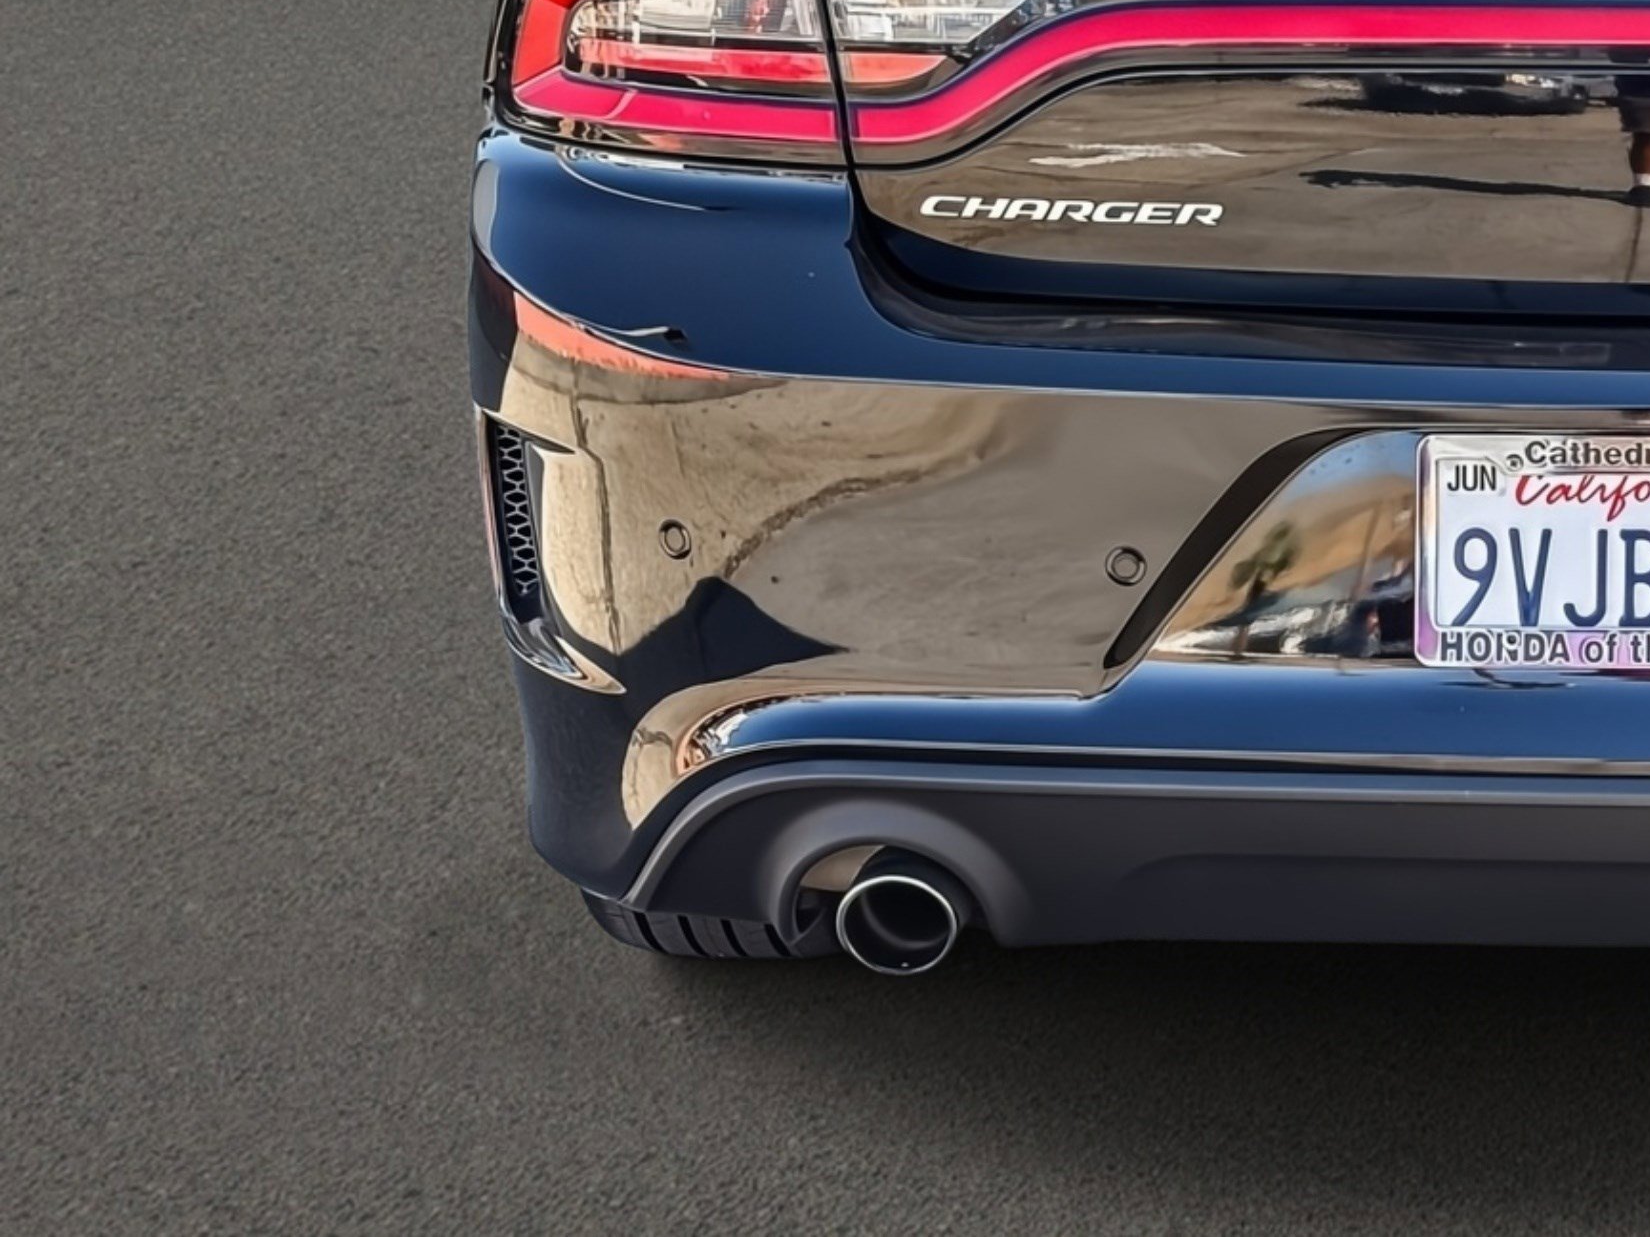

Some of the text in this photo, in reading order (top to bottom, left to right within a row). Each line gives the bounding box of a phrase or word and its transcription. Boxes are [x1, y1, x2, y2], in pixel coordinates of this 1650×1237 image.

[919, 195, 1224, 226] CHARGER
[1447, 466, 1496, 491] JUN
[1440, 633, 1568, 663] HONDA
[1579, 633, 1618, 663] of
